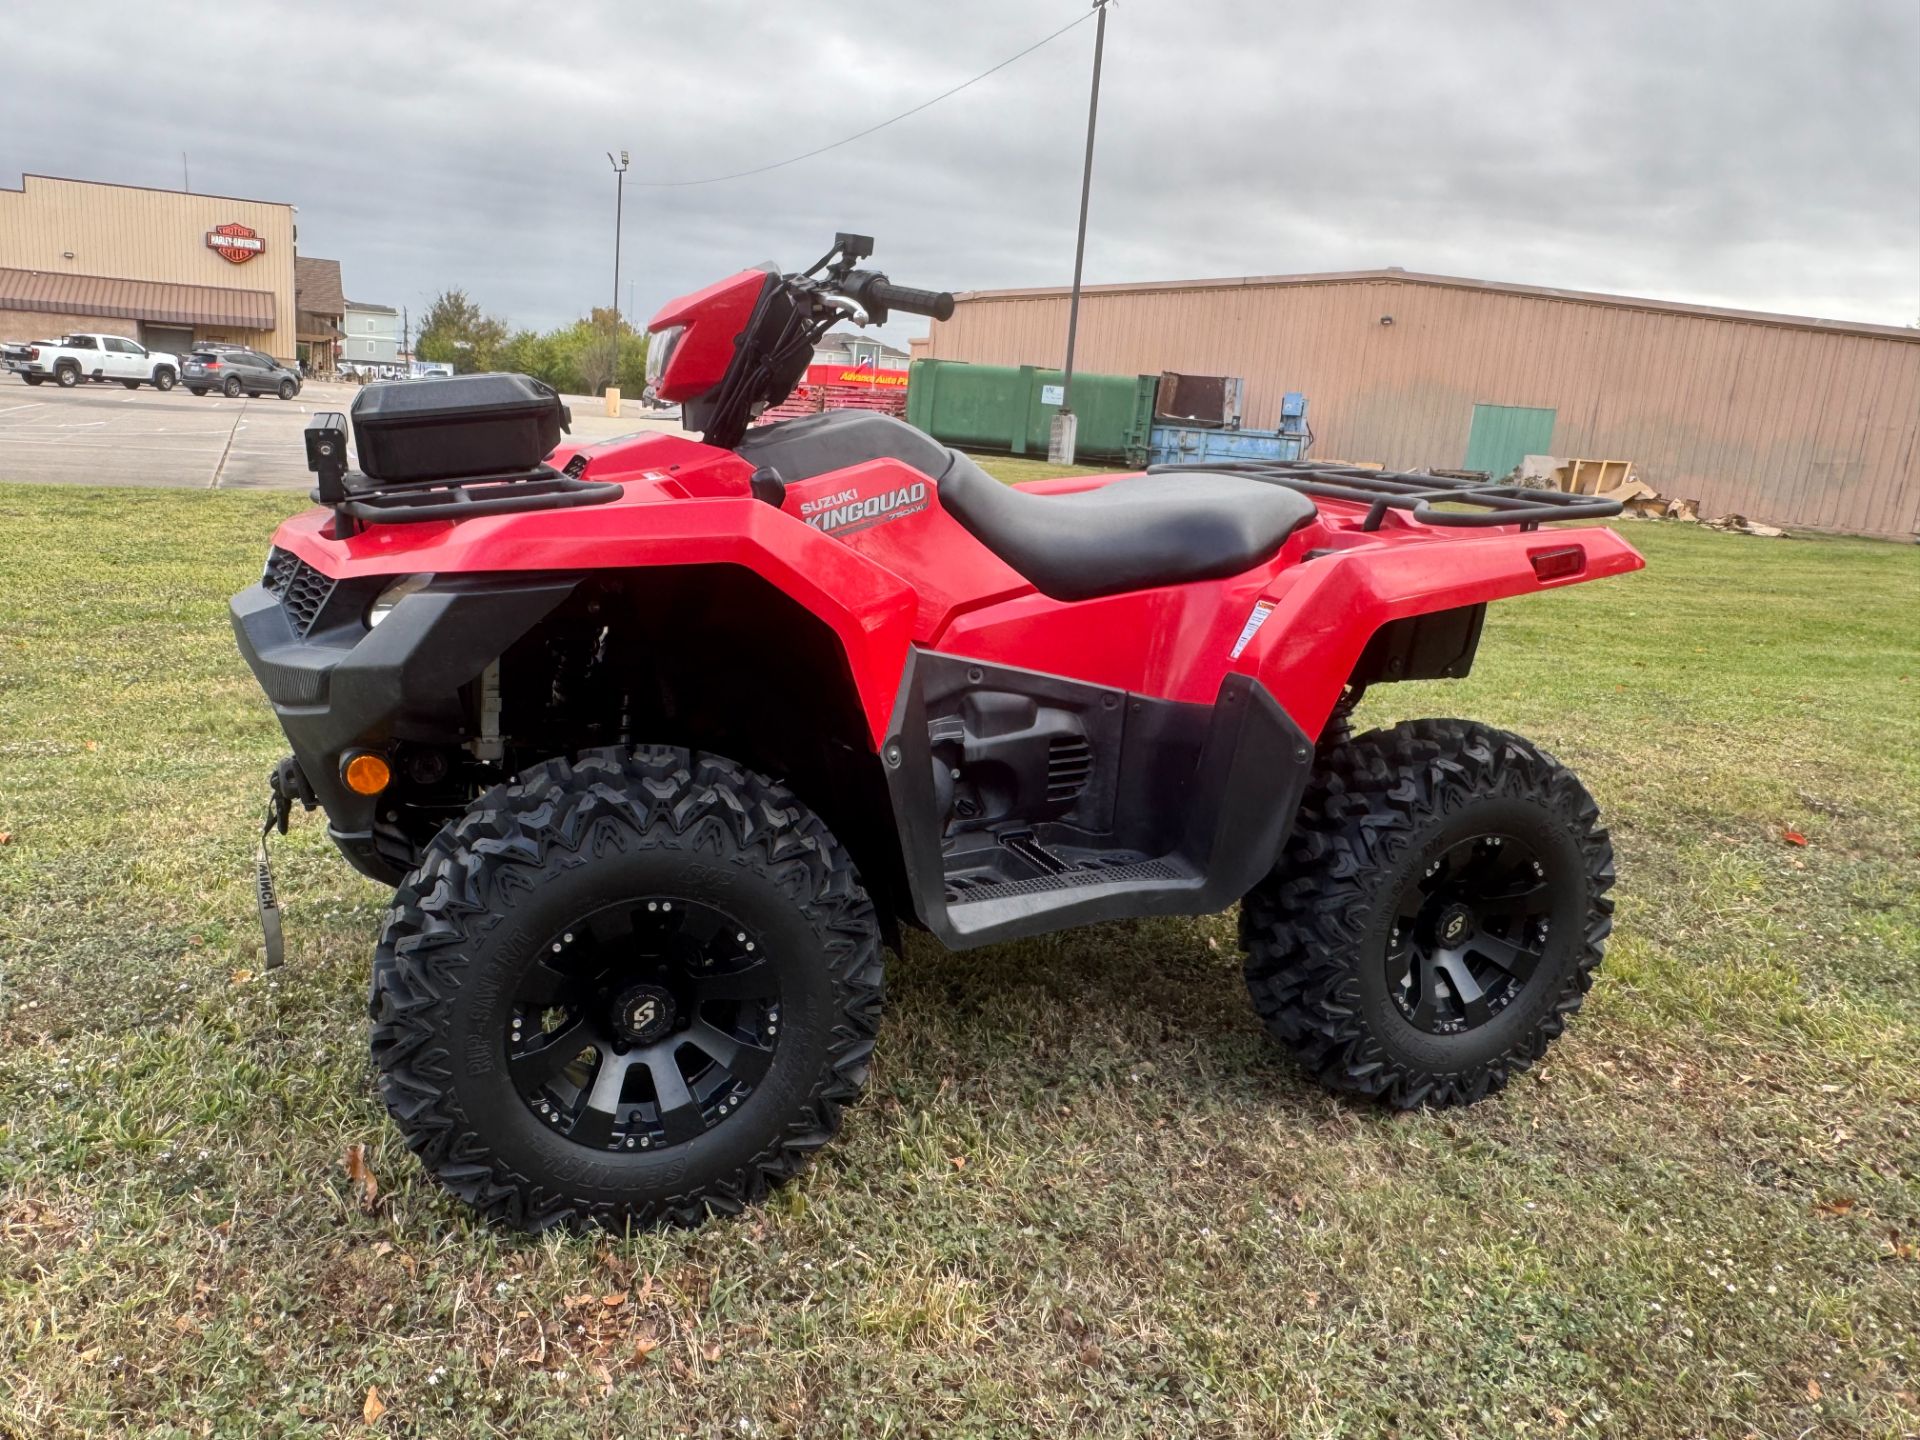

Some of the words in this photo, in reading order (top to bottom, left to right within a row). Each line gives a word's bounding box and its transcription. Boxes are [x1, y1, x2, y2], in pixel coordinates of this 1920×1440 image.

[875, 375, 897, 384] Auto
[800, 488, 859, 514] SUZUKI
[804, 482, 925, 531] KINGQUAD
